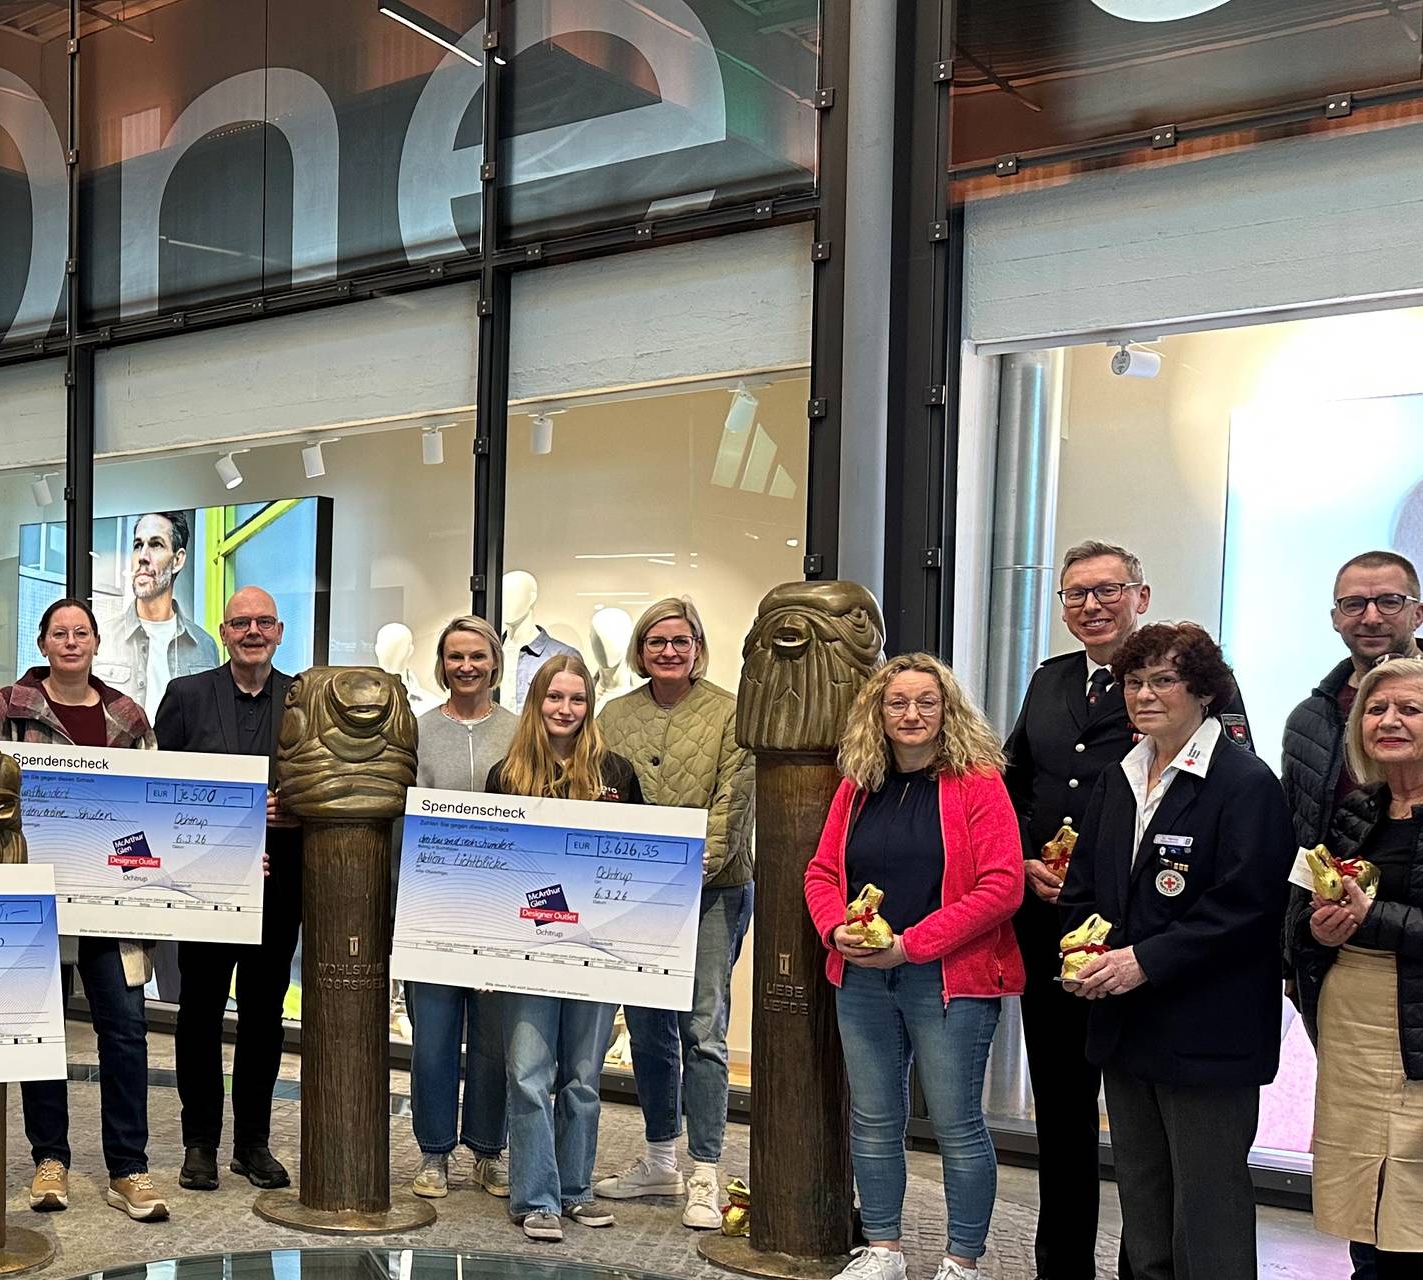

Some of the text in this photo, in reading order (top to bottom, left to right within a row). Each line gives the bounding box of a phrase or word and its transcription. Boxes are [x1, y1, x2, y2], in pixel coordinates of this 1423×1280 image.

[13, 753, 109, 770] Spendenscheck
[153, 790, 167, 798] EUR
[421, 799, 526, 819] Spendenscheck
[573, 841, 590, 850] EUR
[110, 856, 138, 866] Designer
[123, 874, 148, 883] Ochtrup
[596, 865, 633, 886] Ochtrup
[528, 887, 561, 901] McArthur
[530, 899, 547, 908] Glen
[522, 909, 577, 921] Designer Outlet
[536, 929, 563, 938] Ochtrup
